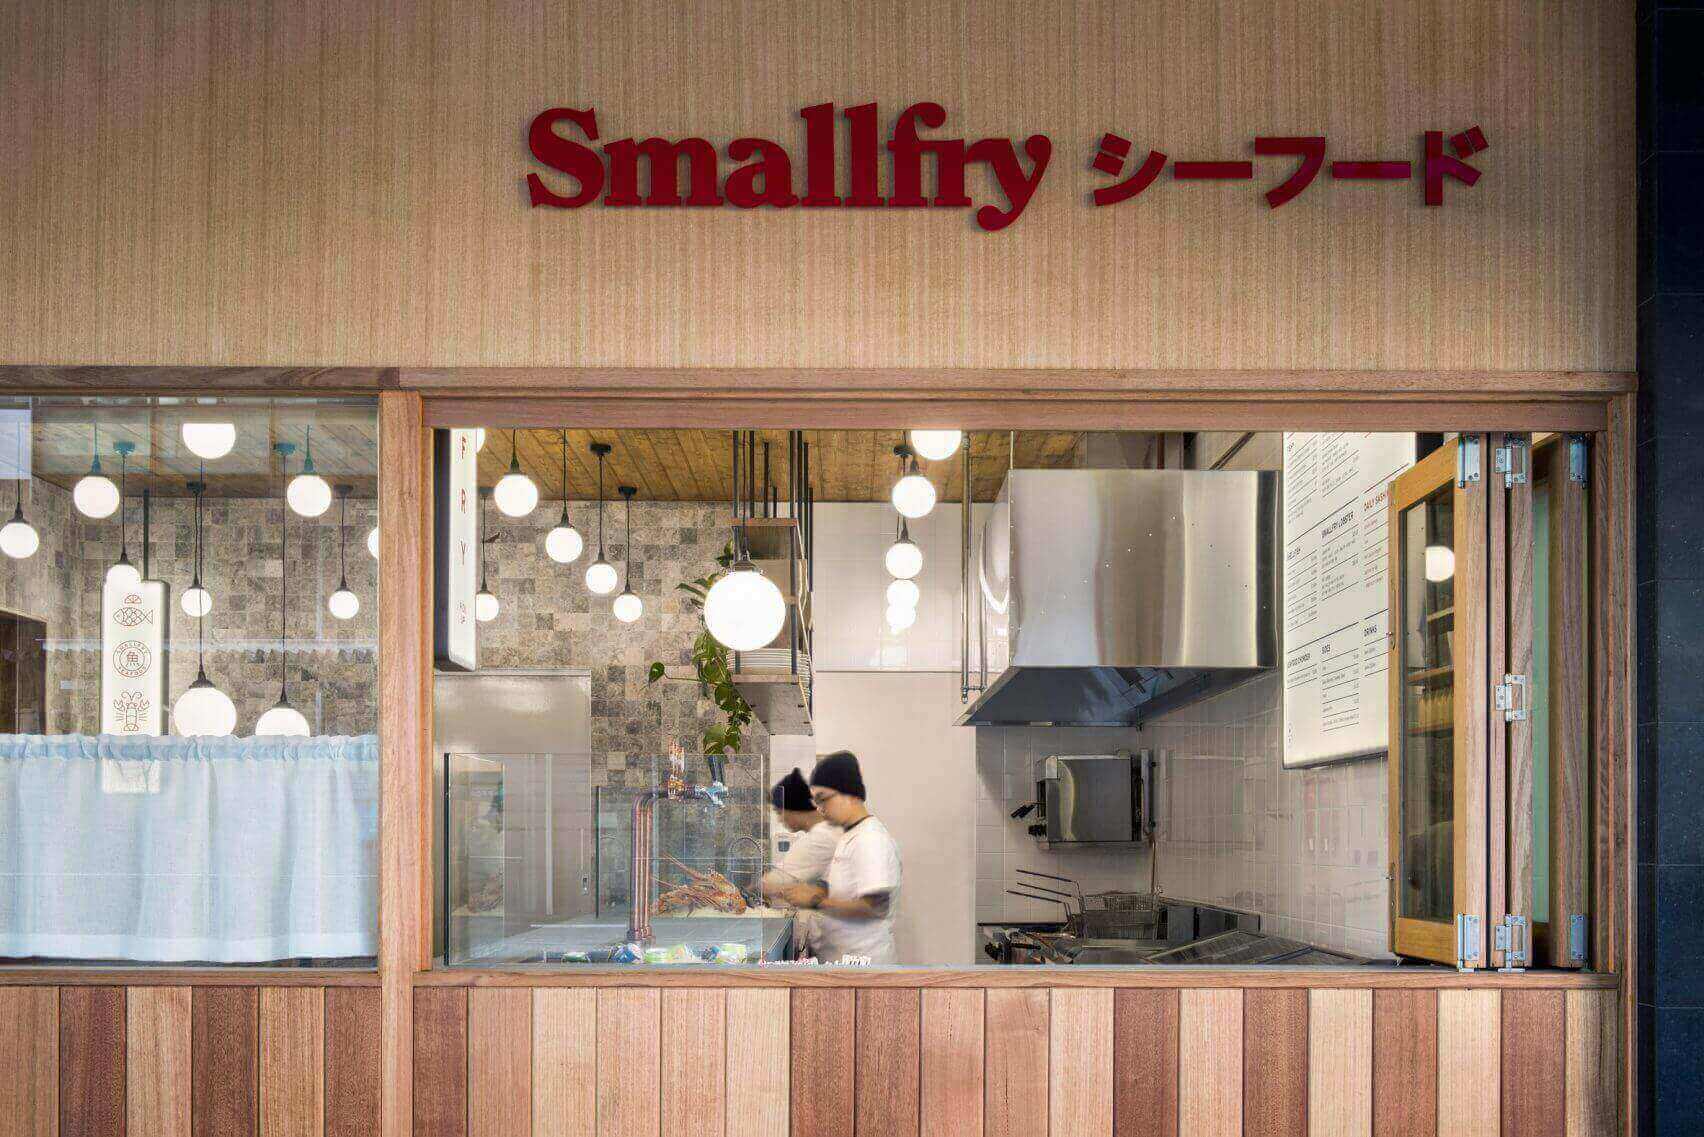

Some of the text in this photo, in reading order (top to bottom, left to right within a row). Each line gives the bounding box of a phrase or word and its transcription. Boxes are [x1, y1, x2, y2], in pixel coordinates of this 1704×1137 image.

[527, 102, 1489, 231] Smallfry シーフード
